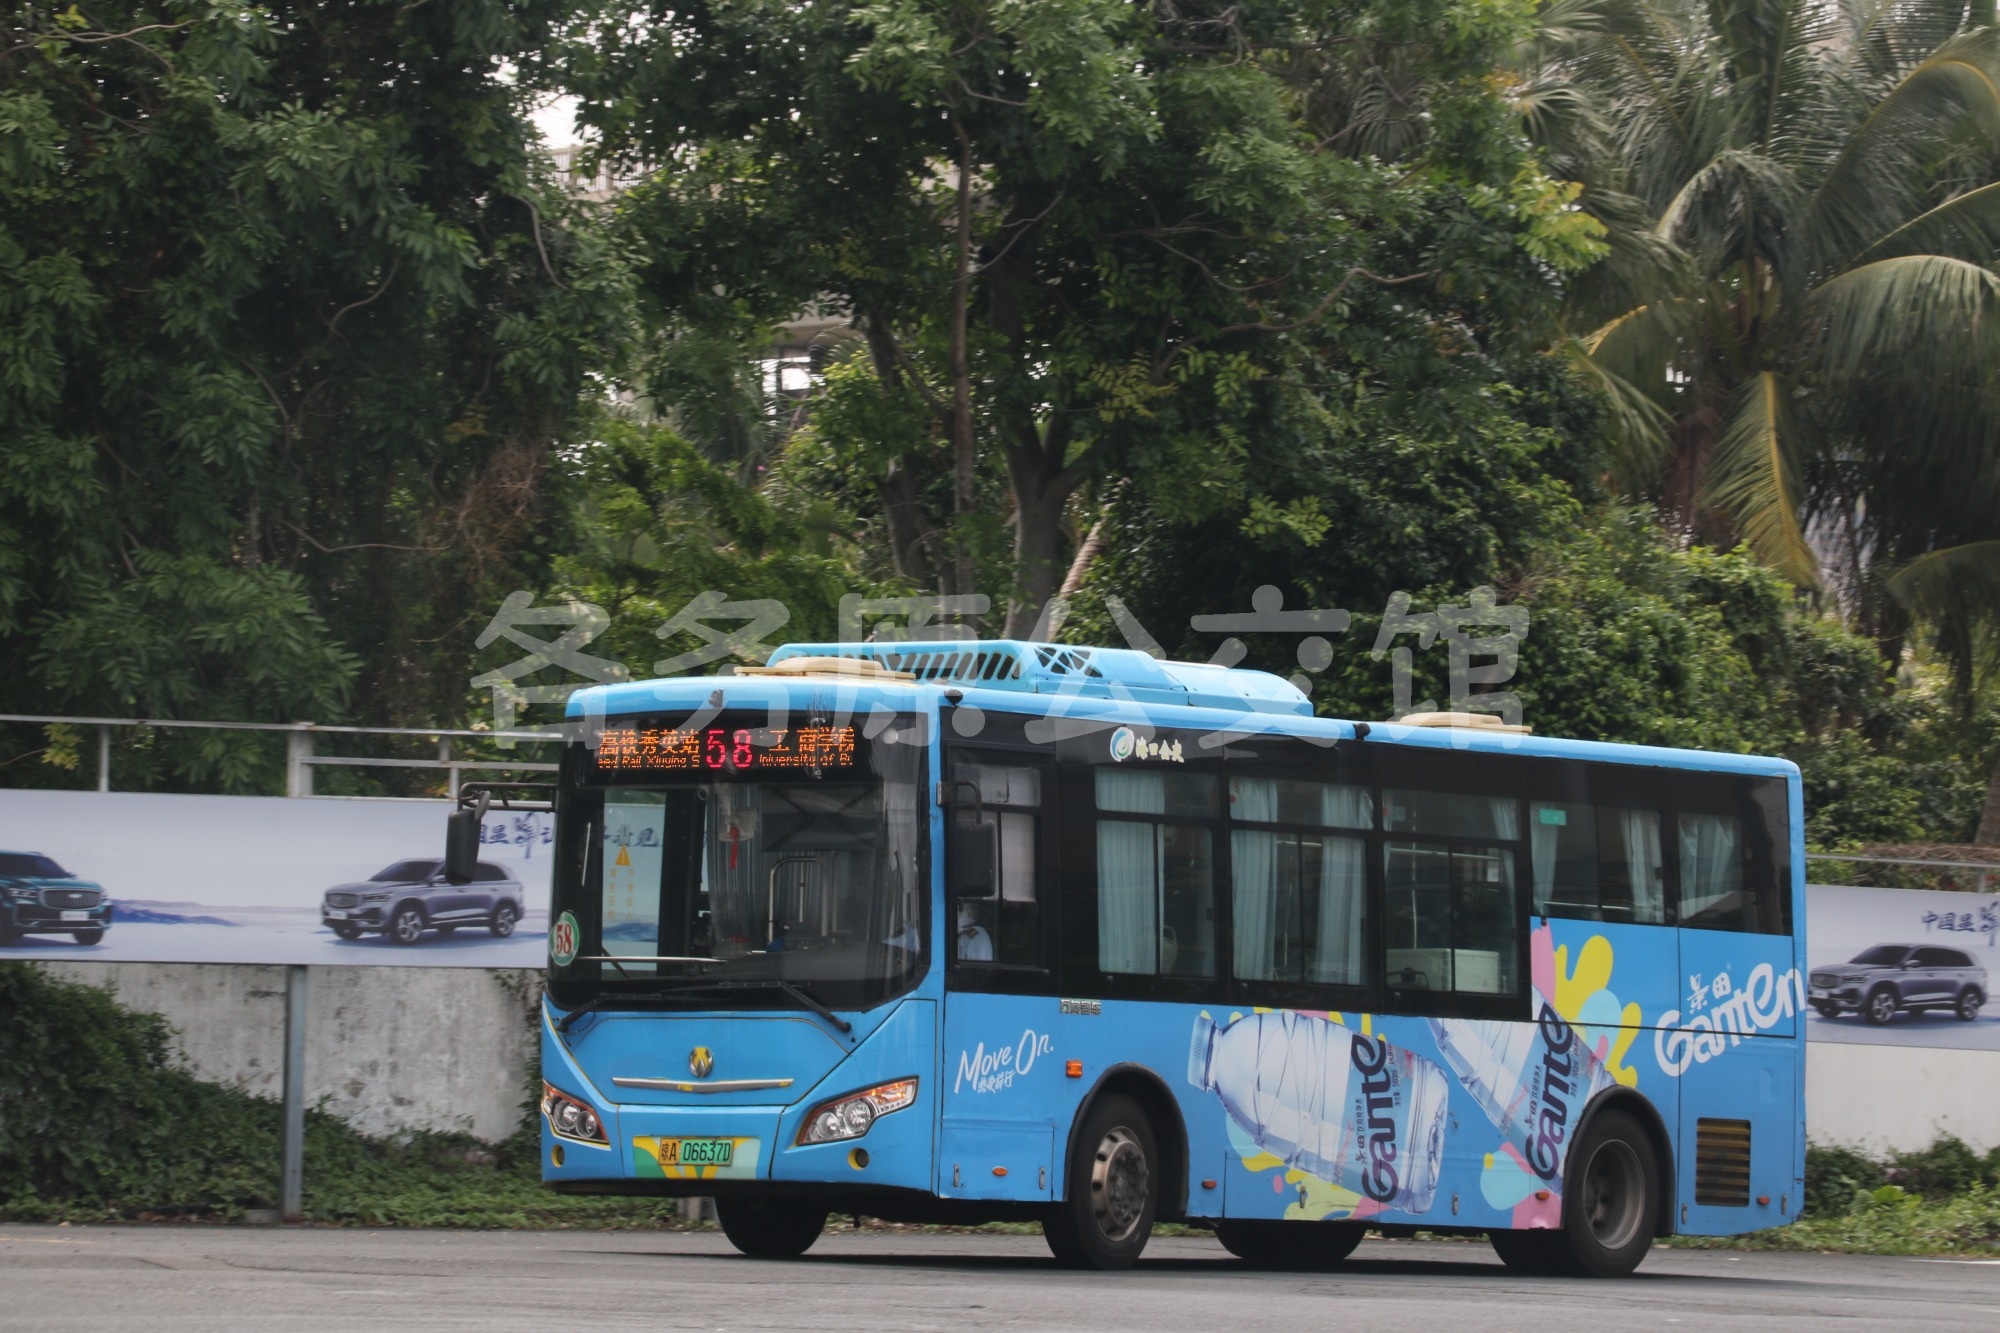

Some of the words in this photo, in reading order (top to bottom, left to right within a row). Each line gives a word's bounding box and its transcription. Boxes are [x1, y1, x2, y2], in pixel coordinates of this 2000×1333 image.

[706, 729, 753, 768] 58
[556, 923, 572, 954] 58
[1687, 972, 1732, 1014] 景田
[1655, 963, 1806, 1077] Ganten
[954, 1042, 1013, 1094] Move
[683, 1142, 731, 1161] 06637D
